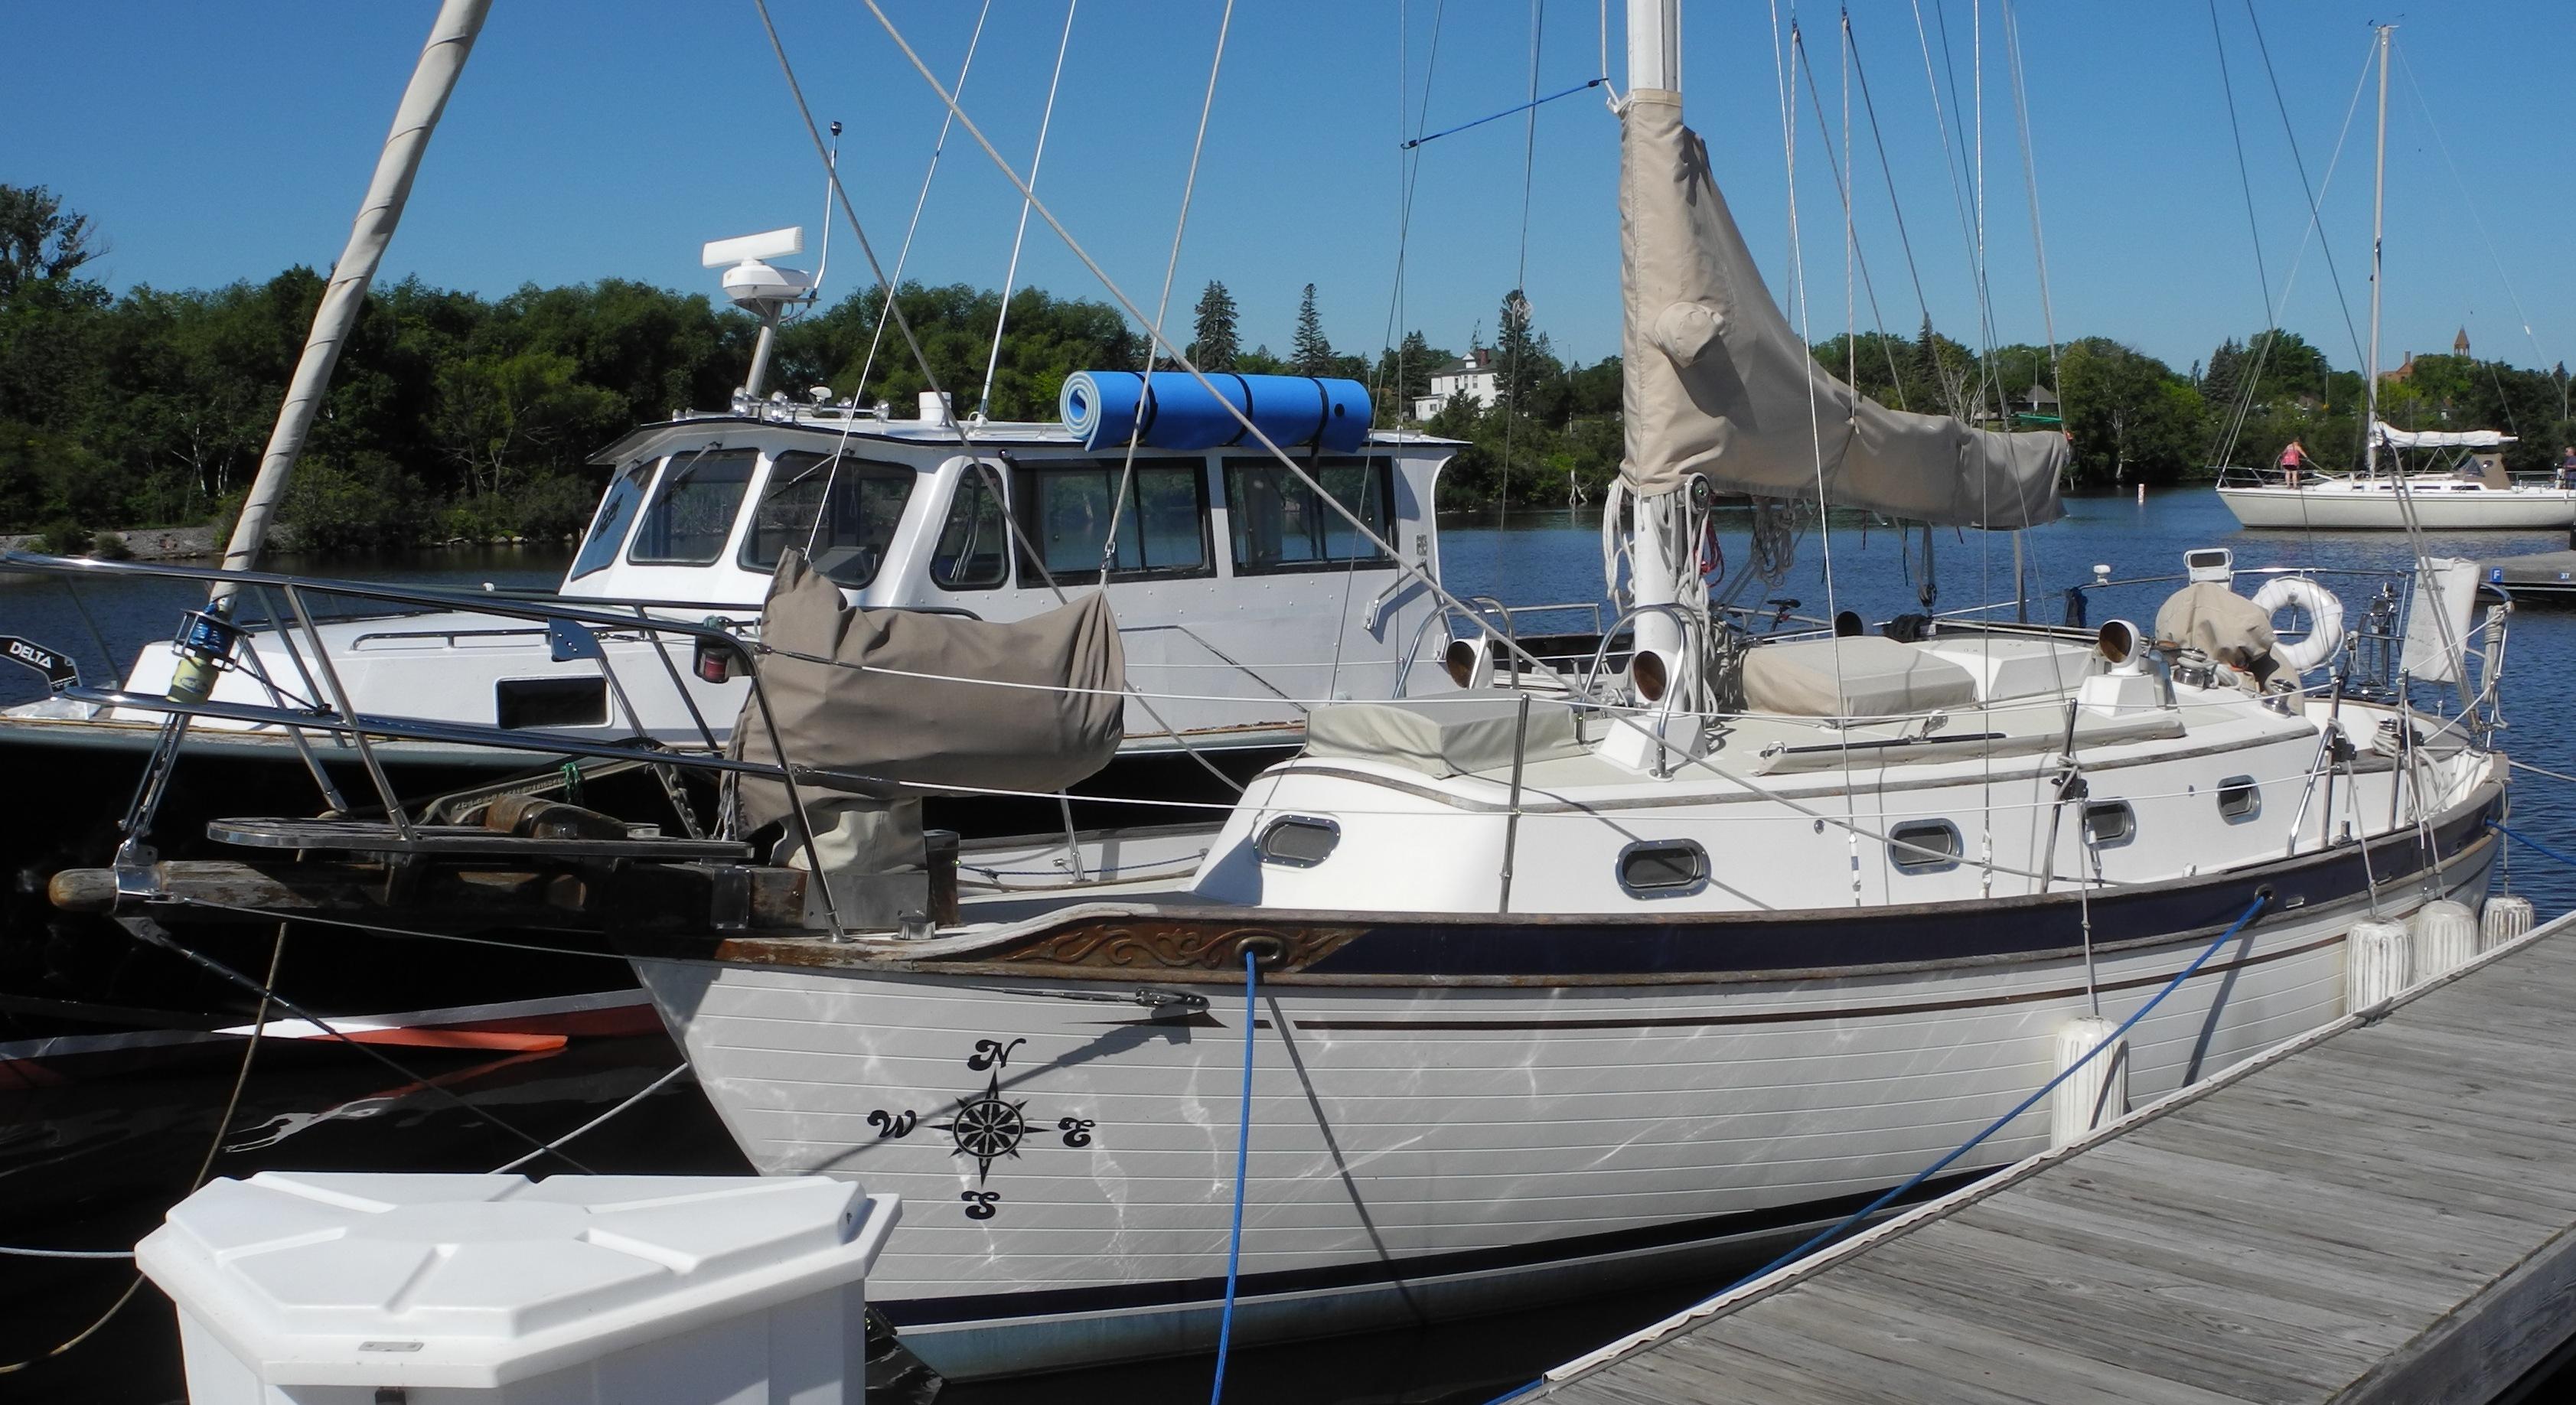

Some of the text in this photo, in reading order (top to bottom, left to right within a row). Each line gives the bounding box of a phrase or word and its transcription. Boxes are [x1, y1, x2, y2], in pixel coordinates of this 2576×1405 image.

[2493, 569, 2501, 579] F
[9, 641, 52, 669] DELTA
[967, 1038, 1026, 1071] N
[867, 1110, 917, 1139] W
[1058, 1117, 1096, 1147] E
[960, 1190, 1001, 1220] S
